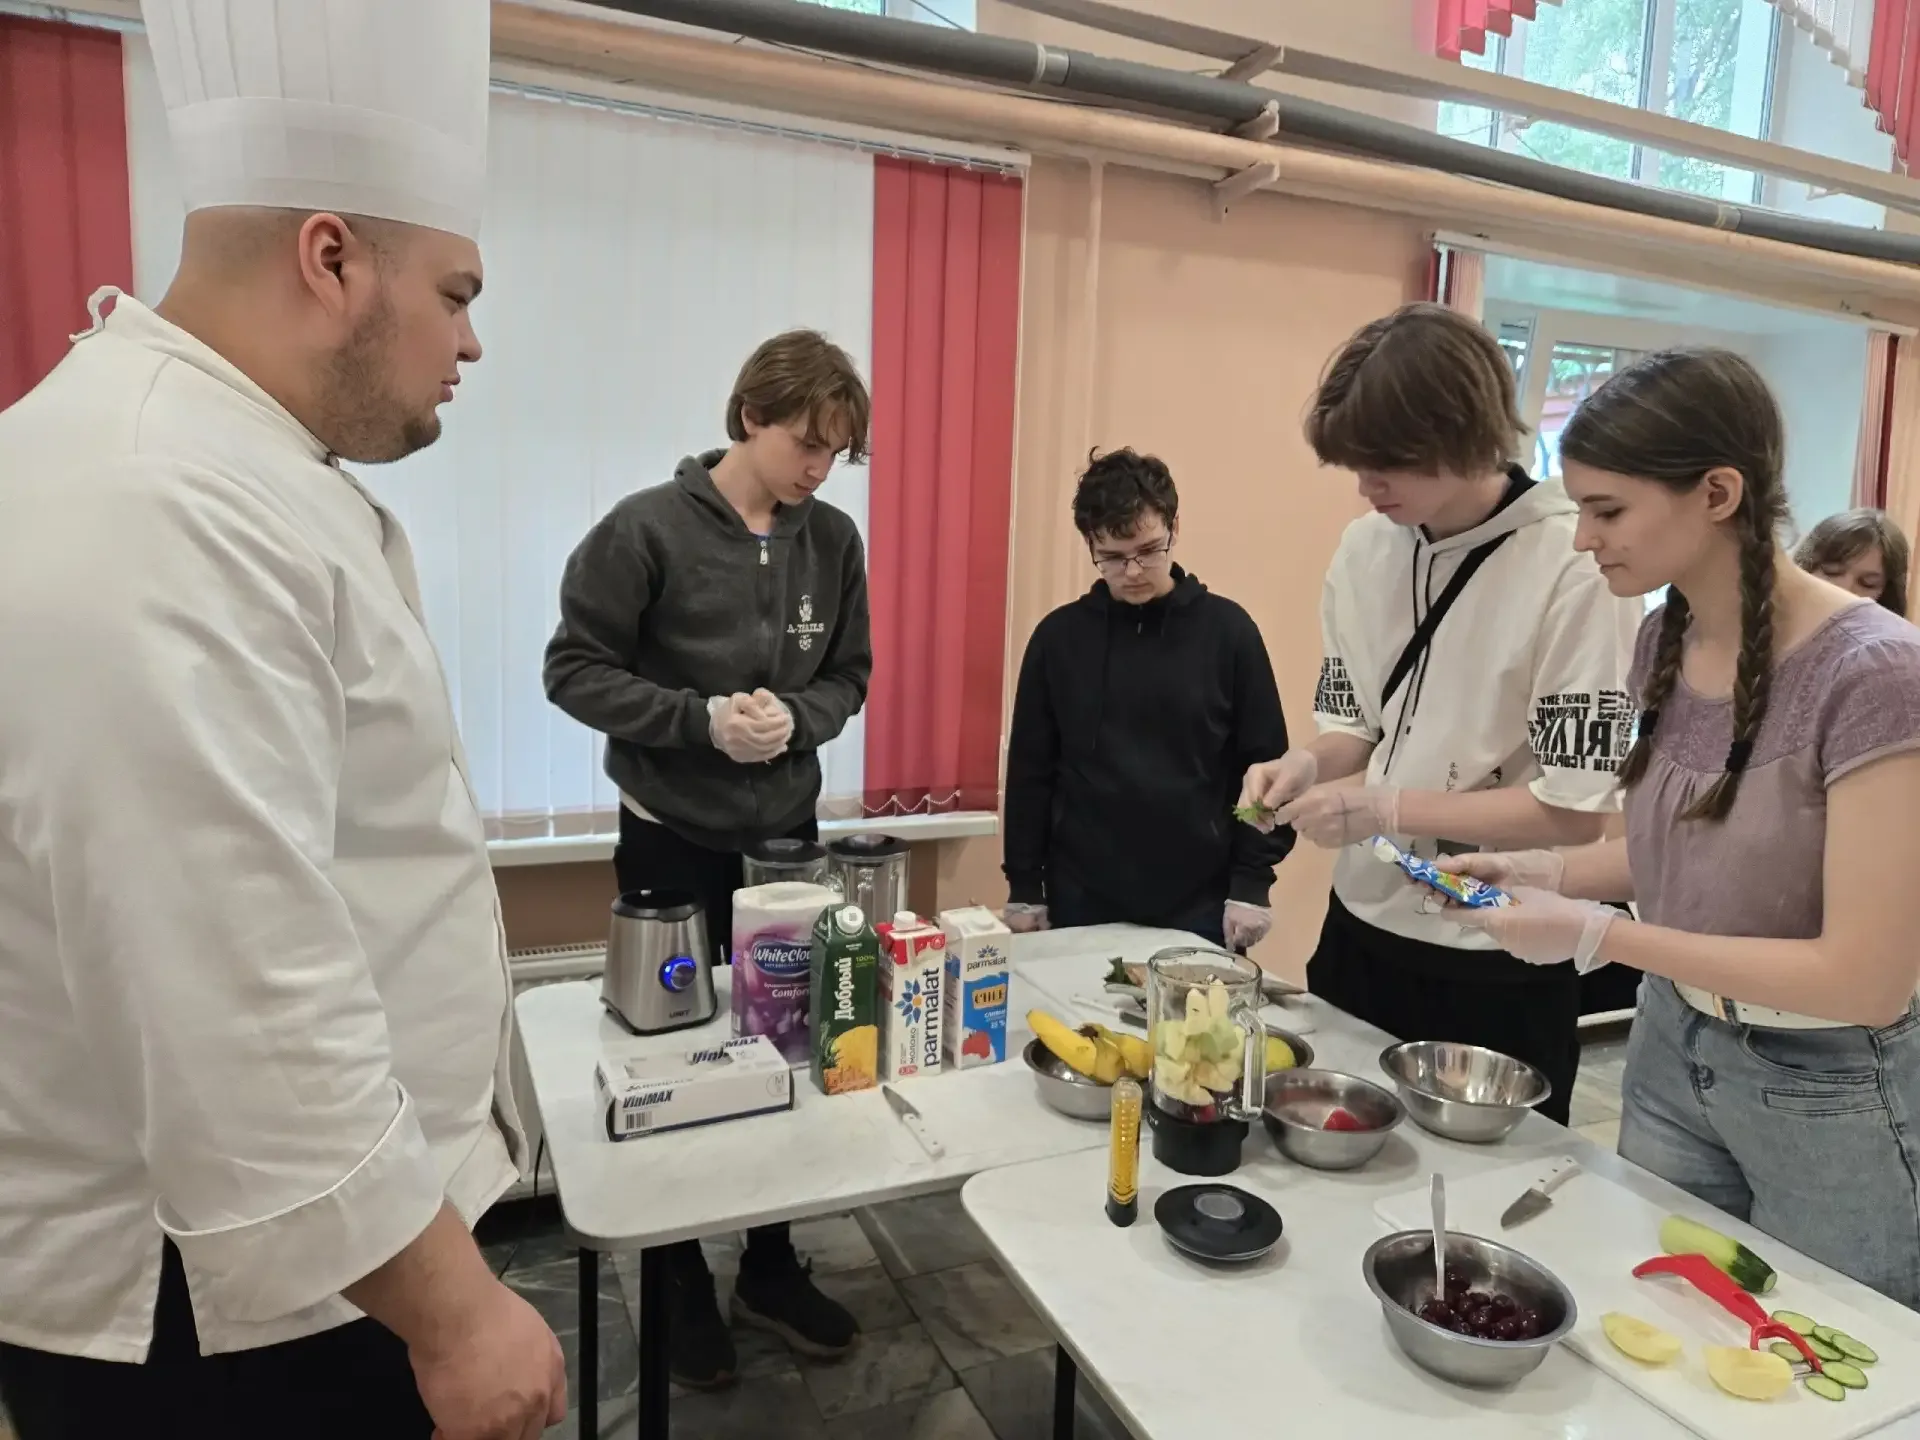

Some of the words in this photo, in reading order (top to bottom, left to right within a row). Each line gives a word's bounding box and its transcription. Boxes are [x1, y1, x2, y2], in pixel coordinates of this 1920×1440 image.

[753, 947, 811, 963] WhiteClo
[855, 955, 876, 963] 100%
[966, 956, 1007, 972] parmalat
[772, 987, 811, 999] Comfor
[833, 956, 855, 1021] Добрый
[921, 967, 940, 1068] parmalat
[774, 1075, 785, 1086] M
[623, 1089, 674, 1109] ViniMAX
